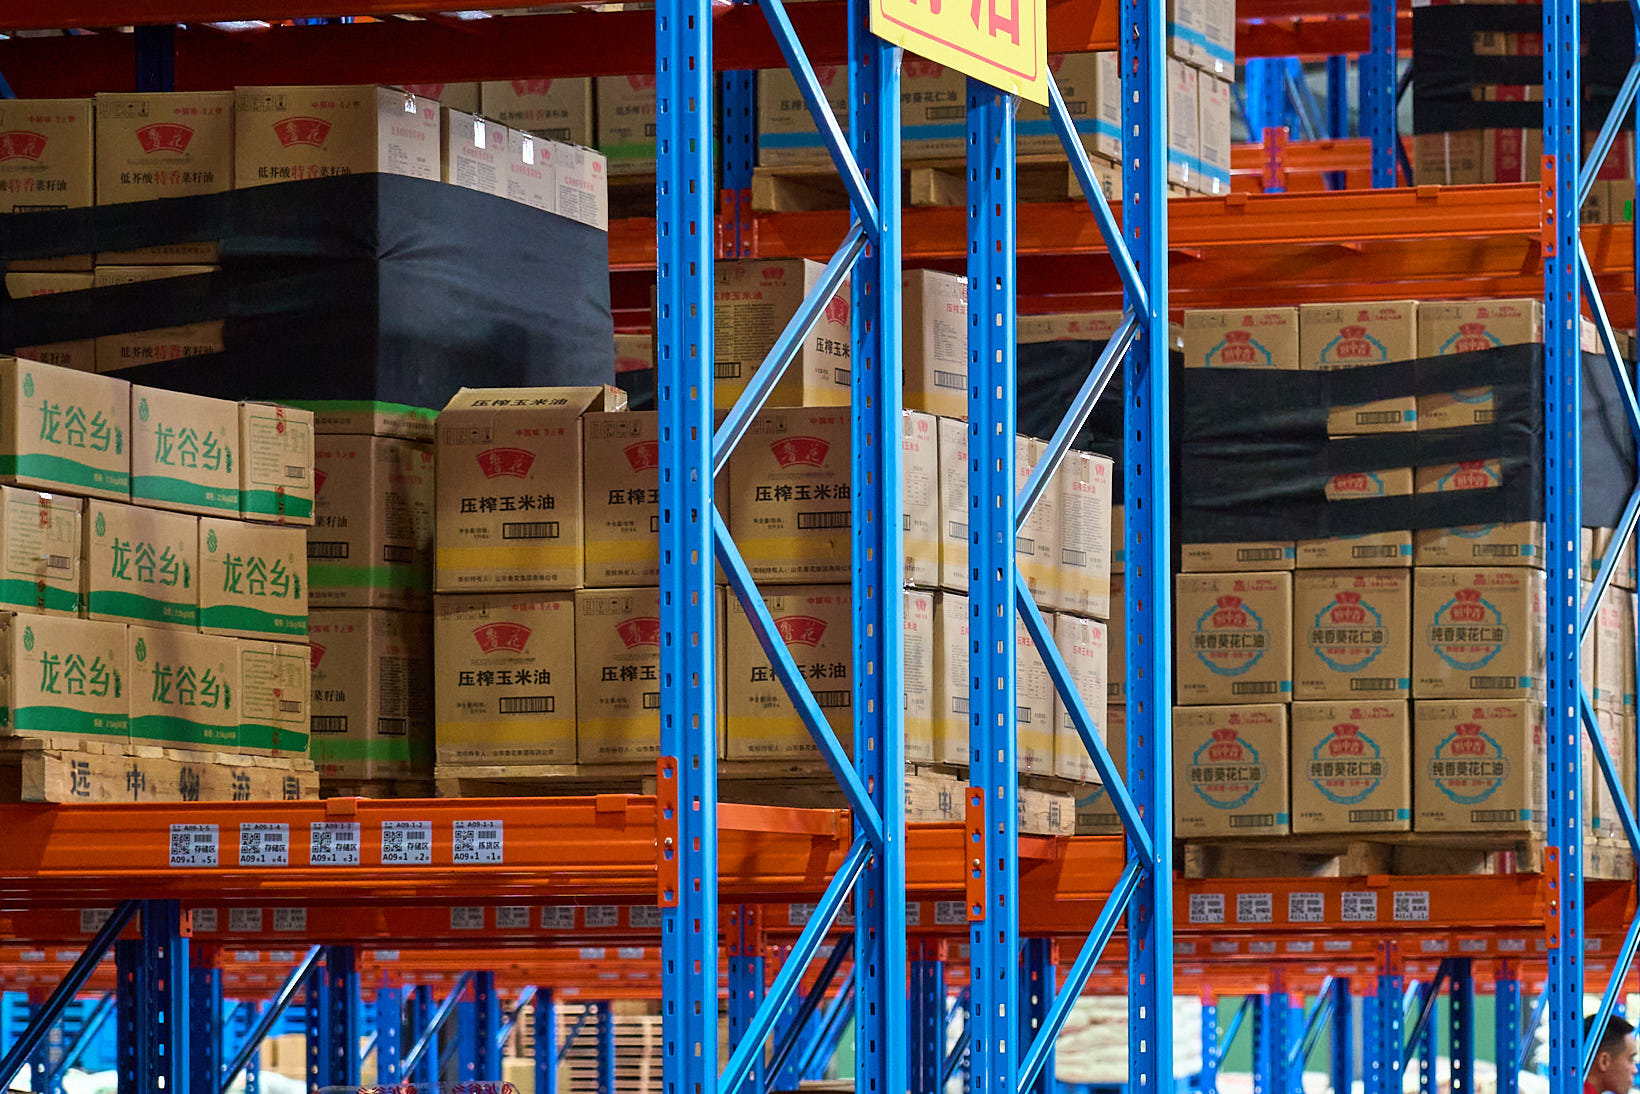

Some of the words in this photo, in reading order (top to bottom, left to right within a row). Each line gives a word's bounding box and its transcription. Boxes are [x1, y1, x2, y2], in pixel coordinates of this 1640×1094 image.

[40, 400, 113, 451] 龙谷乡
[154, 423, 222, 471] 龙谷乡
[460, 494, 555, 514] 压榨玉米油
[755, 484, 851, 502] 压榨玉米油
[111, 538, 180, 587] 龙谷乡
[223, 553, 289, 599] 龙谷乡
[40, 652, 110, 698] 龙谷乡
[152, 662, 221, 708] 龙谷乡
[458, 669, 551, 686] 压榨玉米油
[601, 665, 660, 682] 压榨玉
[751, 663, 846, 683] 压米油
